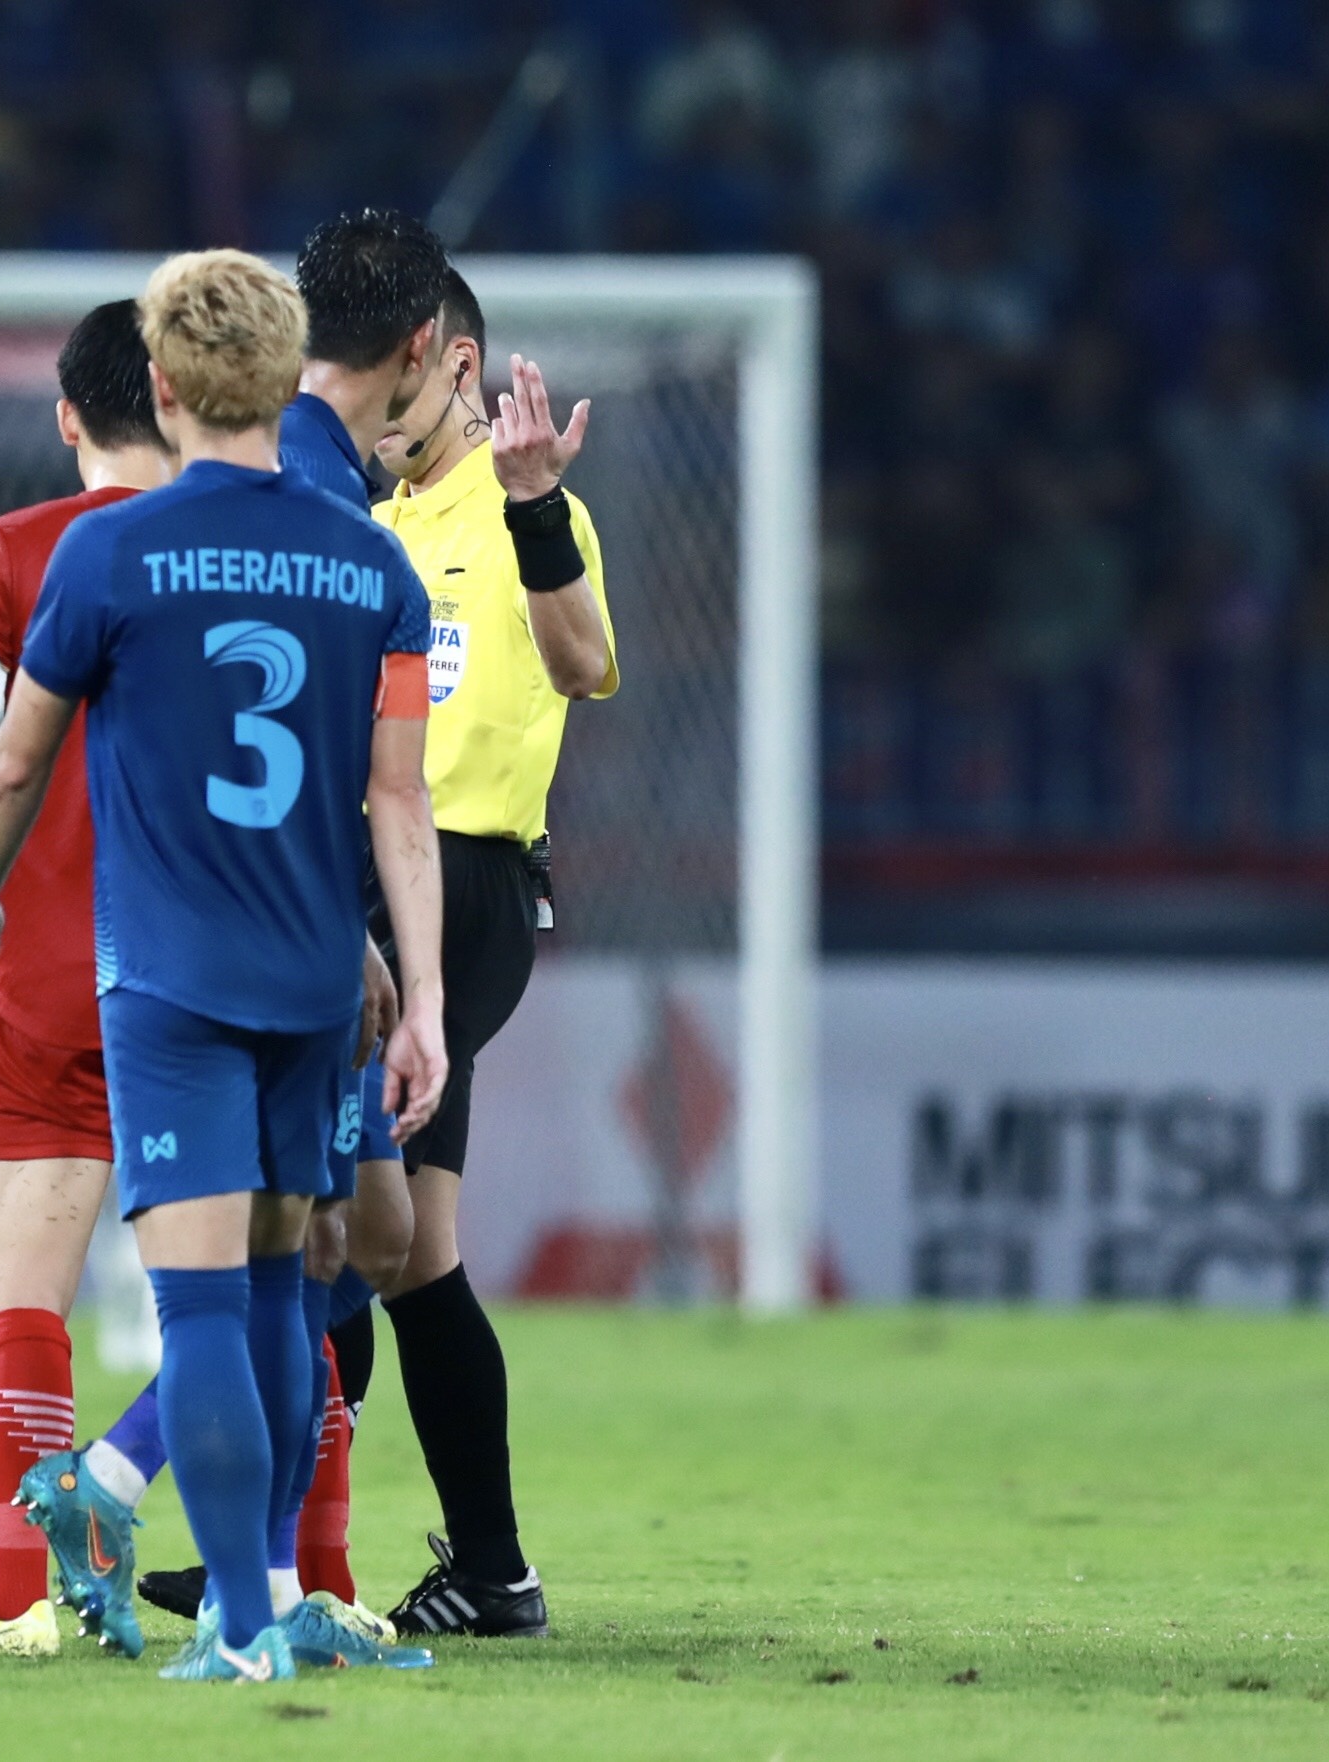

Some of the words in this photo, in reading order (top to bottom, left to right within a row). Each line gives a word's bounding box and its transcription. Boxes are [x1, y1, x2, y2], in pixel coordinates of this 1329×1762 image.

[142, 547, 384, 612] THEERATHON
[431, 626, 461, 648] IFA
[204, 620, 307, 829] 3
